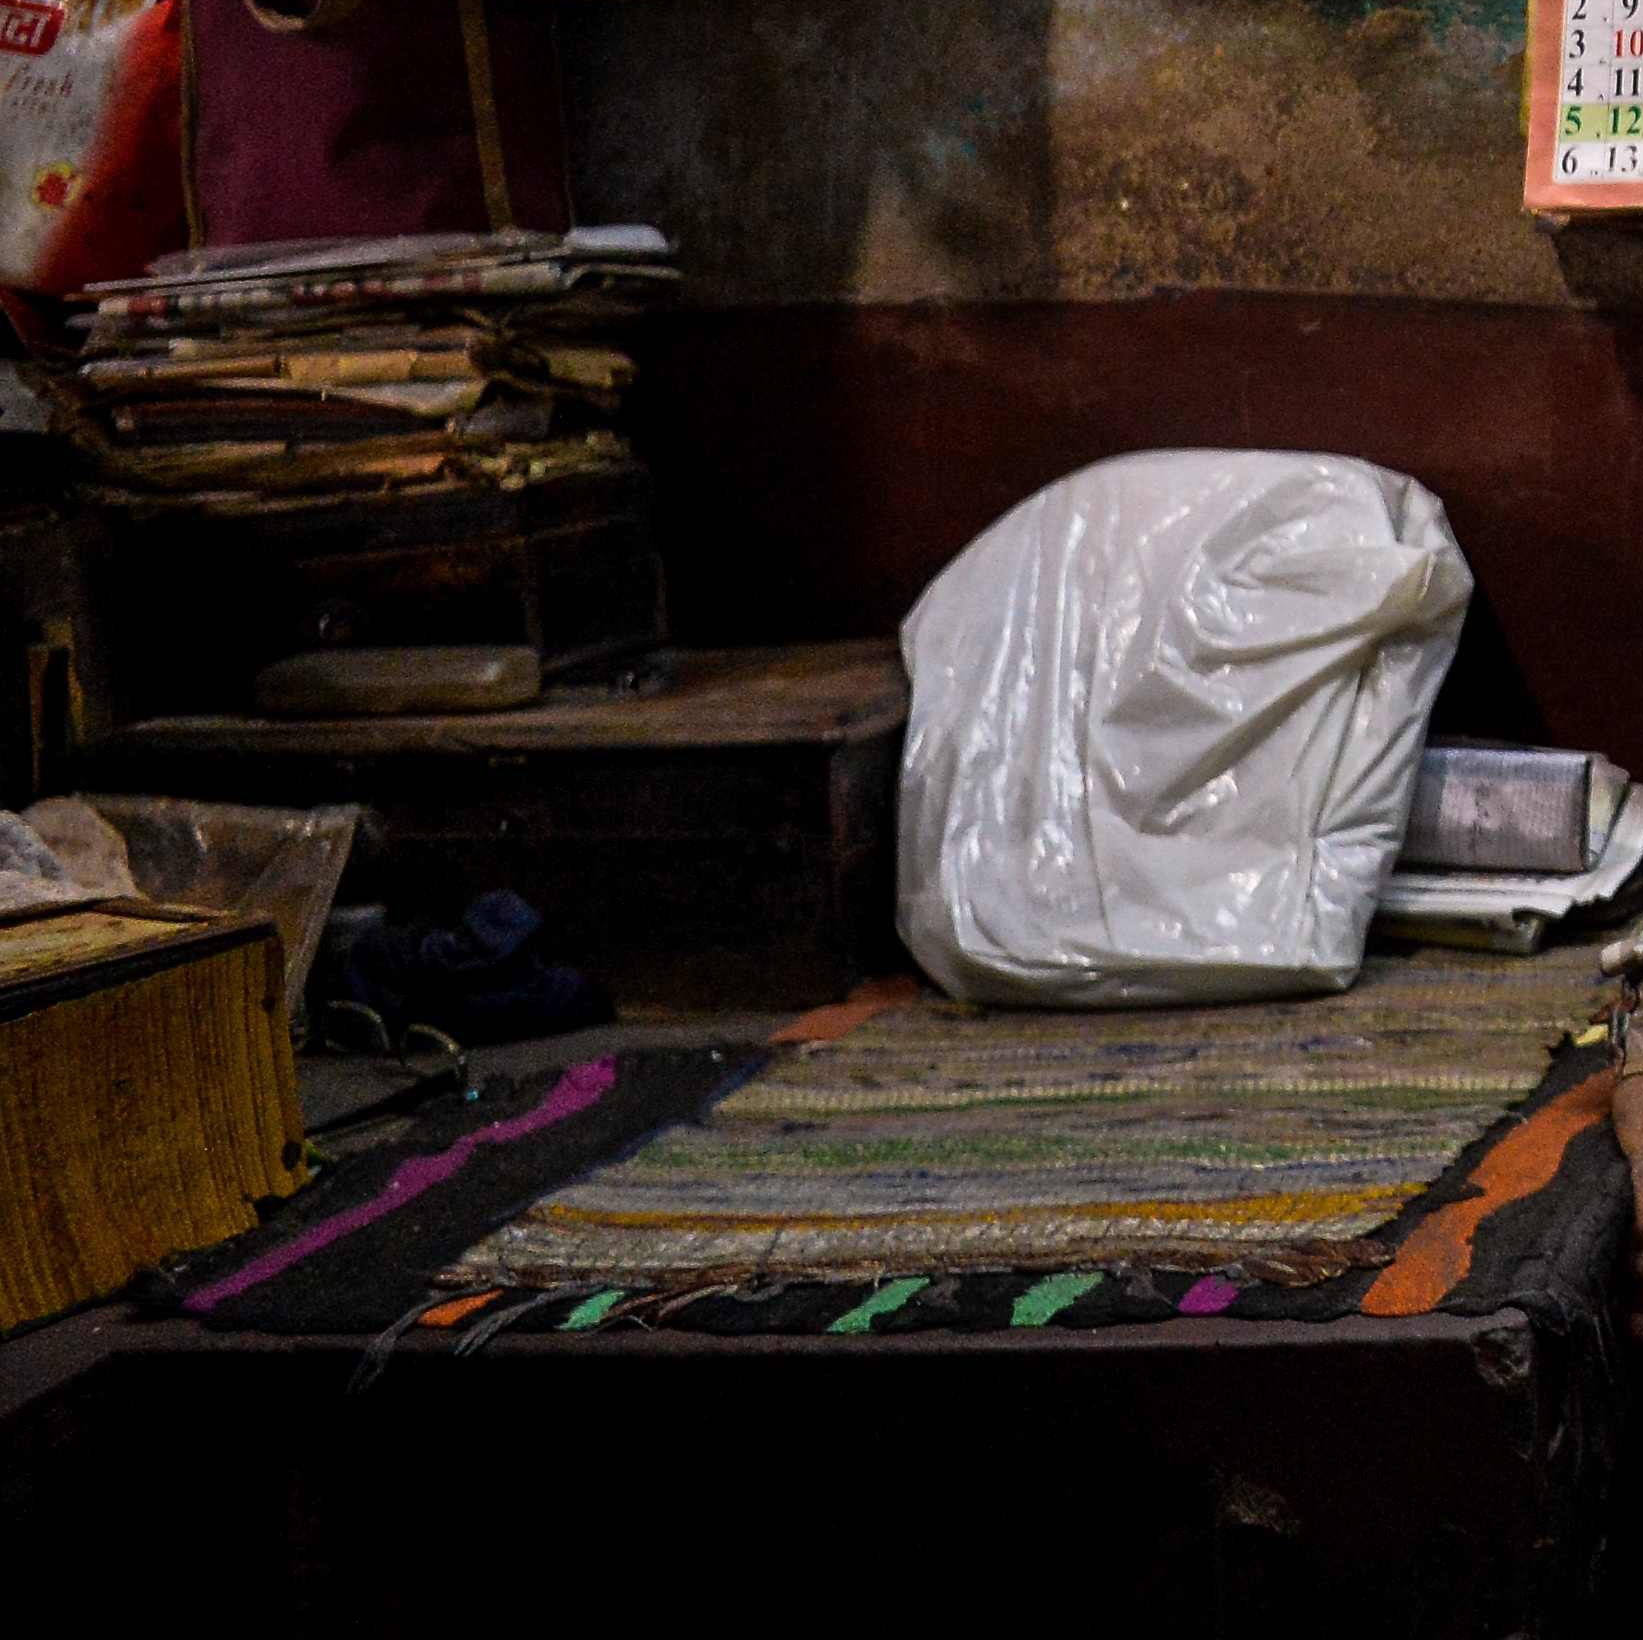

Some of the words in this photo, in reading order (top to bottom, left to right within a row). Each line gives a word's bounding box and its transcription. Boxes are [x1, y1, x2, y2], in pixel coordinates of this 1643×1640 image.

[1569, 29, 1585, 58] 3
[1568, 68, 1583, 96] 4
[1614, 68, 1640, 95] 11
[1565, 106, 1582, 135] 5
[1610, 106, 1641, 134] 12
[1562, 147, 1578, 174] 6
[1608, 146, 1637, 172] 13
